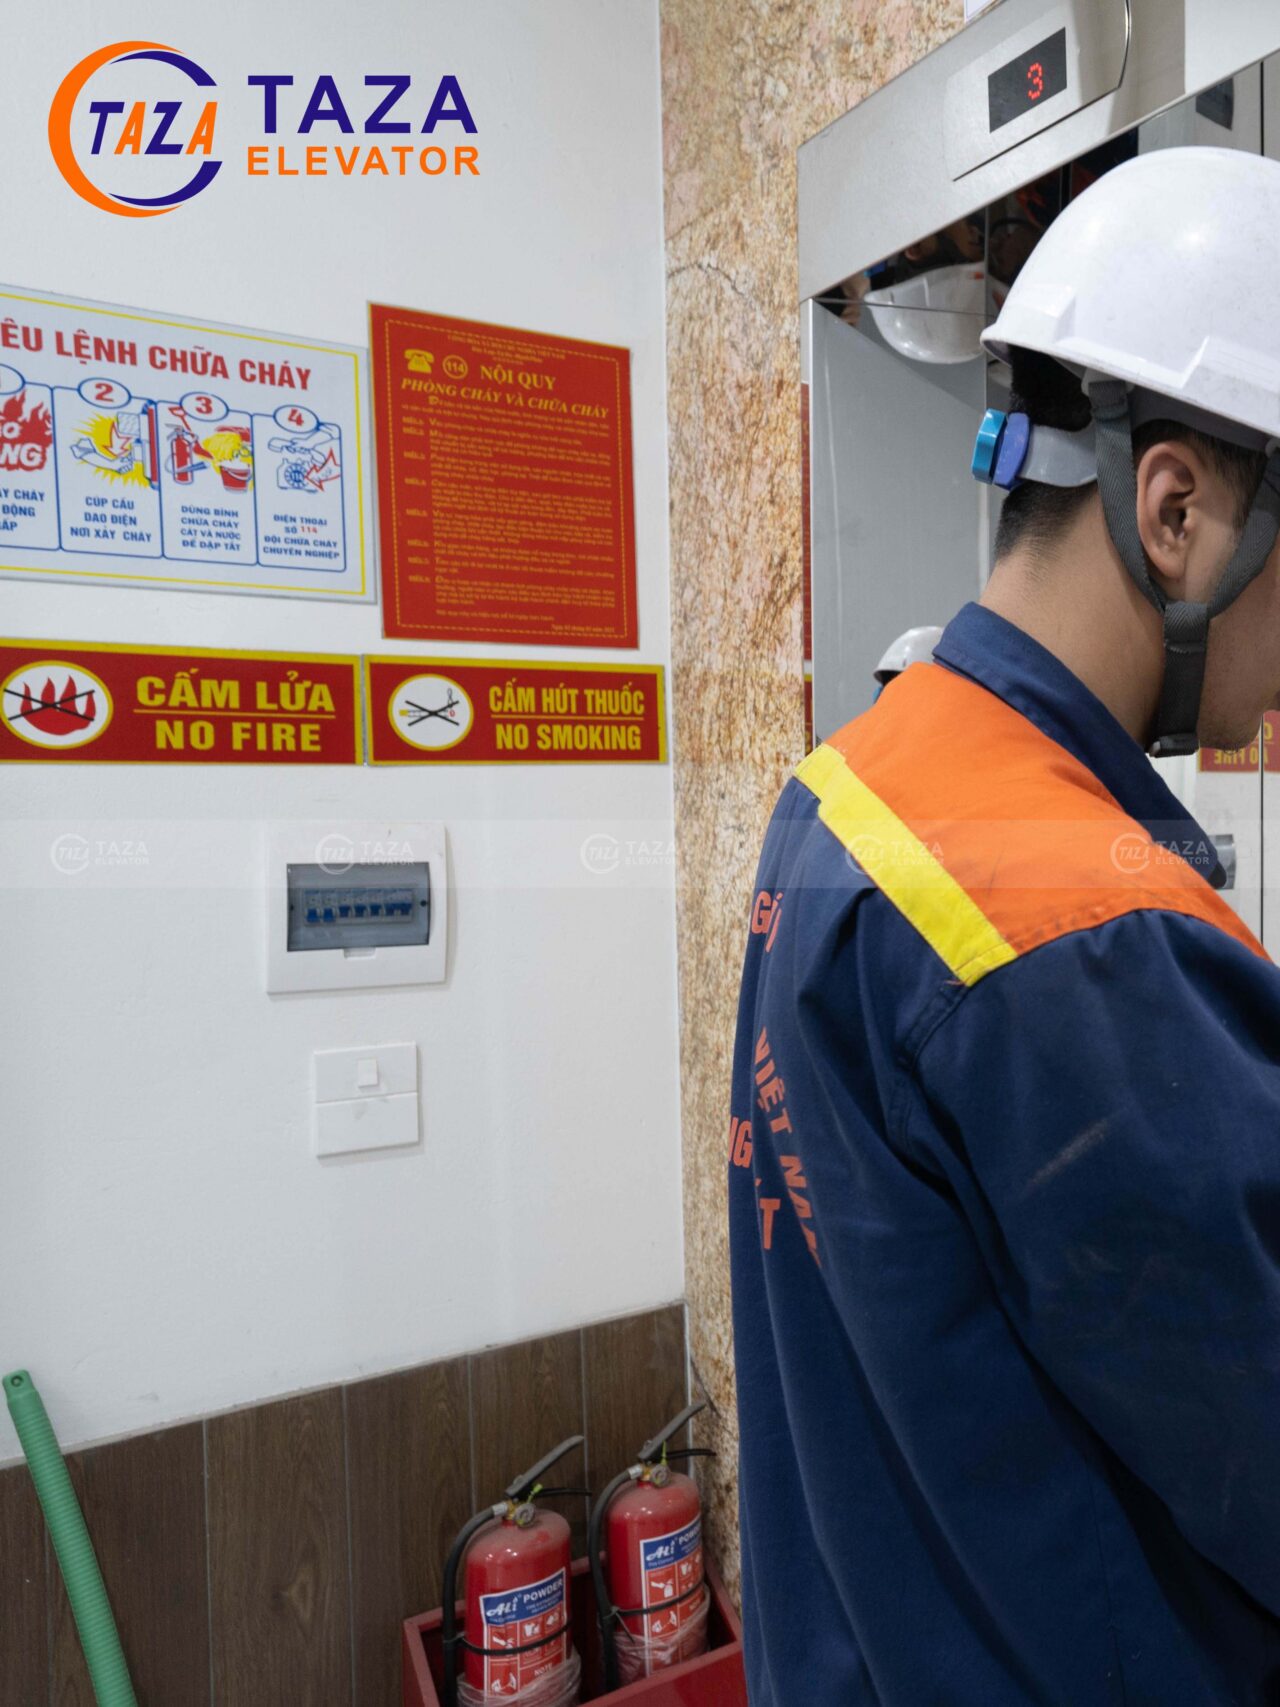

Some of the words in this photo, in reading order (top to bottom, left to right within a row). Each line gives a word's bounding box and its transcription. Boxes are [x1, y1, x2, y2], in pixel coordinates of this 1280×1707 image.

[1028, 62, 1043, 98] 3
[55, 329, 138, 366] LỆNH
[148, 345, 230, 380] CHỮA
[239, 360, 311, 390] CHÁY
[446, 361, 465, 374] 114
[479, 364, 514, 385] NỘI
[517, 372, 556, 391] QUY
[94, 383, 114, 403] 2
[401, 377, 457, 397] PHÒNG
[460, 386, 503, 403] CHÁY
[505, 392, 524, 408] VÀ
[527, 397, 569, 414] CHỮA
[571, 403, 609, 420] CHÁY
[195, 396, 214, 415] 3
[288, 408, 304, 427] 4
[14, 487, 45, 501] CHÁY
[85, 496, 108, 508] CÚP
[2, 504, 36, 517] ĐỘNG
[111, 513, 137, 526] ĐIỆN
[300, 526, 318, 534] 114
[136, 667, 240, 709] CẤM
[255, 670, 336, 711] LỬA
[489, 677, 536, 713] CẤM
[541, 682, 579, 714] HÚT
[584, 681, 645, 715] THUỐC
[155, 719, 215, 750] NO
[231, 721, 322, 751] FIRE
[495, 723, 529, 750] NO
[537, 724, 642, 750] SMOKING
[523, 1578, 563, 1604] POWDER
